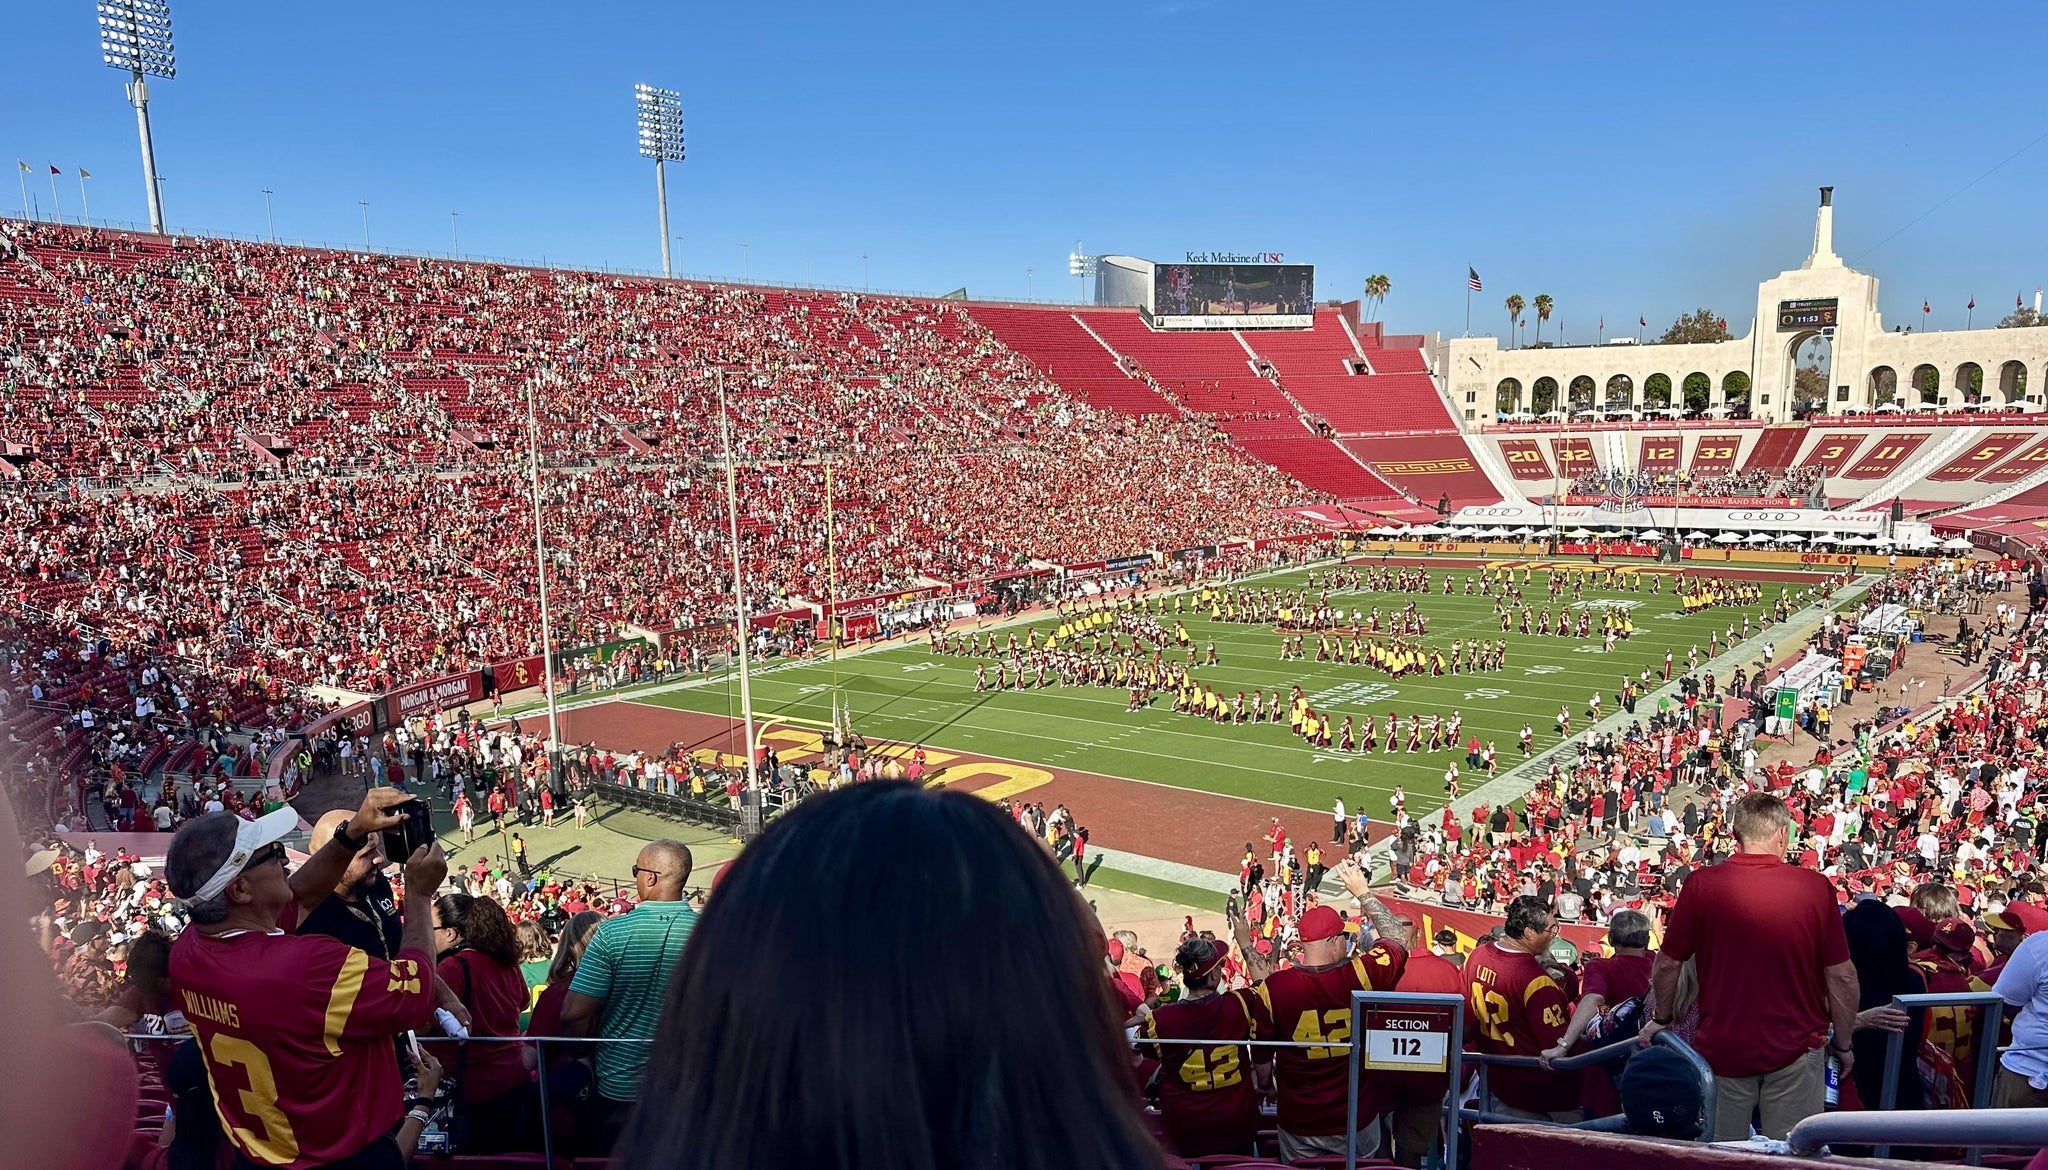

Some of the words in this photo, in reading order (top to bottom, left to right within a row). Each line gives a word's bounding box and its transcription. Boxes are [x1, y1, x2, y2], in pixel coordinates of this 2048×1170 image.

[1186, 252, 1208, 263] Keck
[1211, 252, 1250, 263] Medicine
[1252, 252, 1262, 263] of
[1263, 253, 1284, 263] USC
[1236, 316, 1252, 325] Keck
[1255, 316, 1284, 325] Medicine
[1797, 315, 1819, 323] 11:53
[1507, 450, 1540, 462] 20
[1559, 449, 1591, 461] 32
[1647, 447, 1675, 460] 12
[1698, 447, 1734, 459] 33
[1821, 446, 1845, 459] 3
[1874, 446, 1905, 459] 11
[1971, 446, 2003, 460] 5
[1599, 500, 1644, 513] Allstate
[1700, 497, 1728, 505] FAMILY
[1822, 513, 1879, 522] Audi
[1941, 530, 1963, 540] Audi
[515, 661, 528, 684] SC
[400, 688, 428, 711] MORGAN
[435, 678, 468, 700] MORGAN
[1350, 689, 1400, 706] FIELD
[1463, 687, 1511, 700] 30
[1476, 964, 1497, 986] LOTT
[181, 988, 240, 1029] WILLIAMS
[1471, 981, 1515, 1047] 42
[1543, 1003, 1566, 1028] 42
[1385, 1019, 1430, 1031] SECTION
[1292, 1008, 1352, 1060] 42
[1392, 1037, 1422, 1057] 112
[1179, 1044, 1242, 1091] 42
